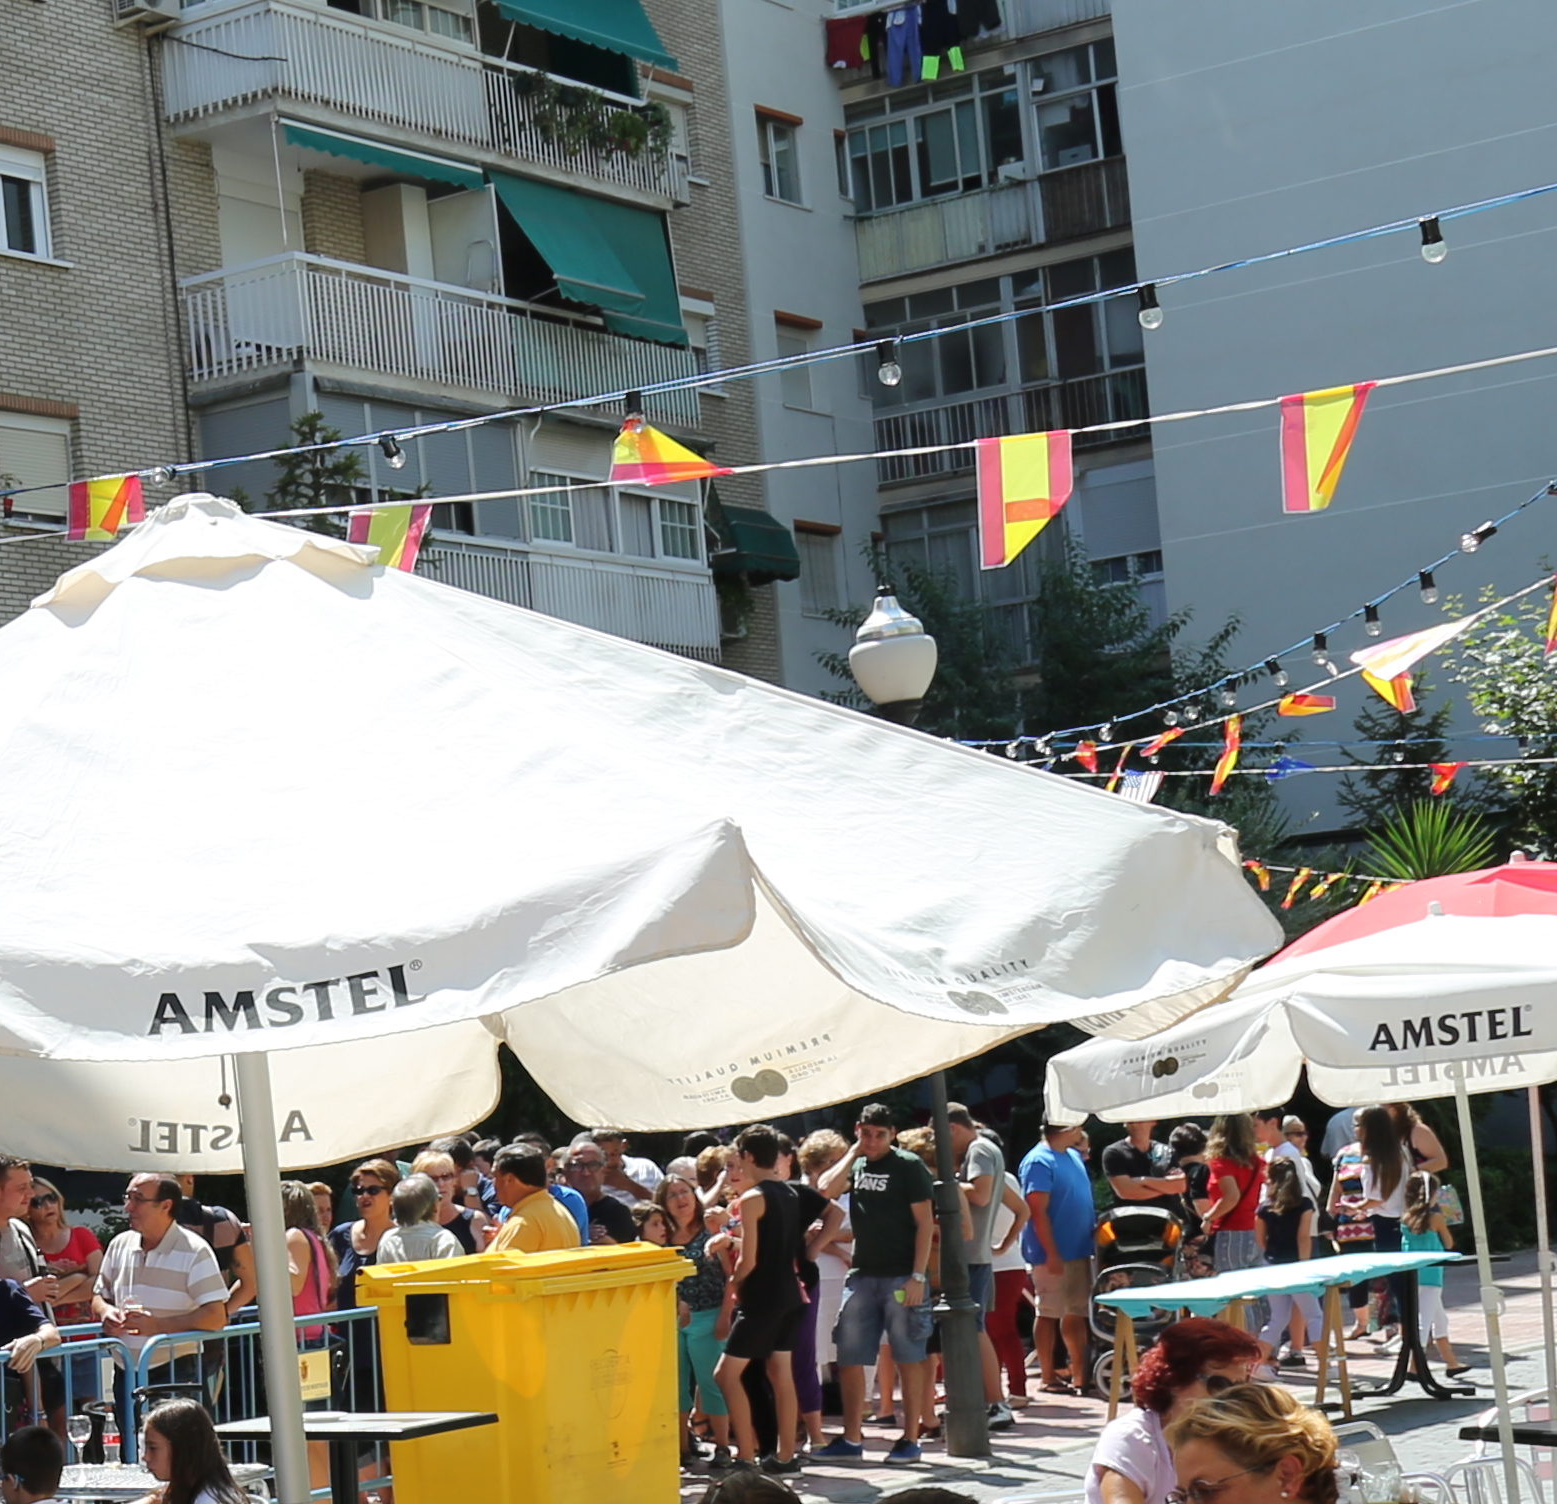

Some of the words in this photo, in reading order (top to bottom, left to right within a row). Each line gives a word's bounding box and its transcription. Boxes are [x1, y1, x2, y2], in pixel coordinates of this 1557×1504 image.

[954, 957, 1031, 986] QUALITY
[146, 963, 428, 1036] AMSTEL
[1366, 1005, 1534, 1052] AMSTEL
[853, 1171, 891, 1192] VANS
